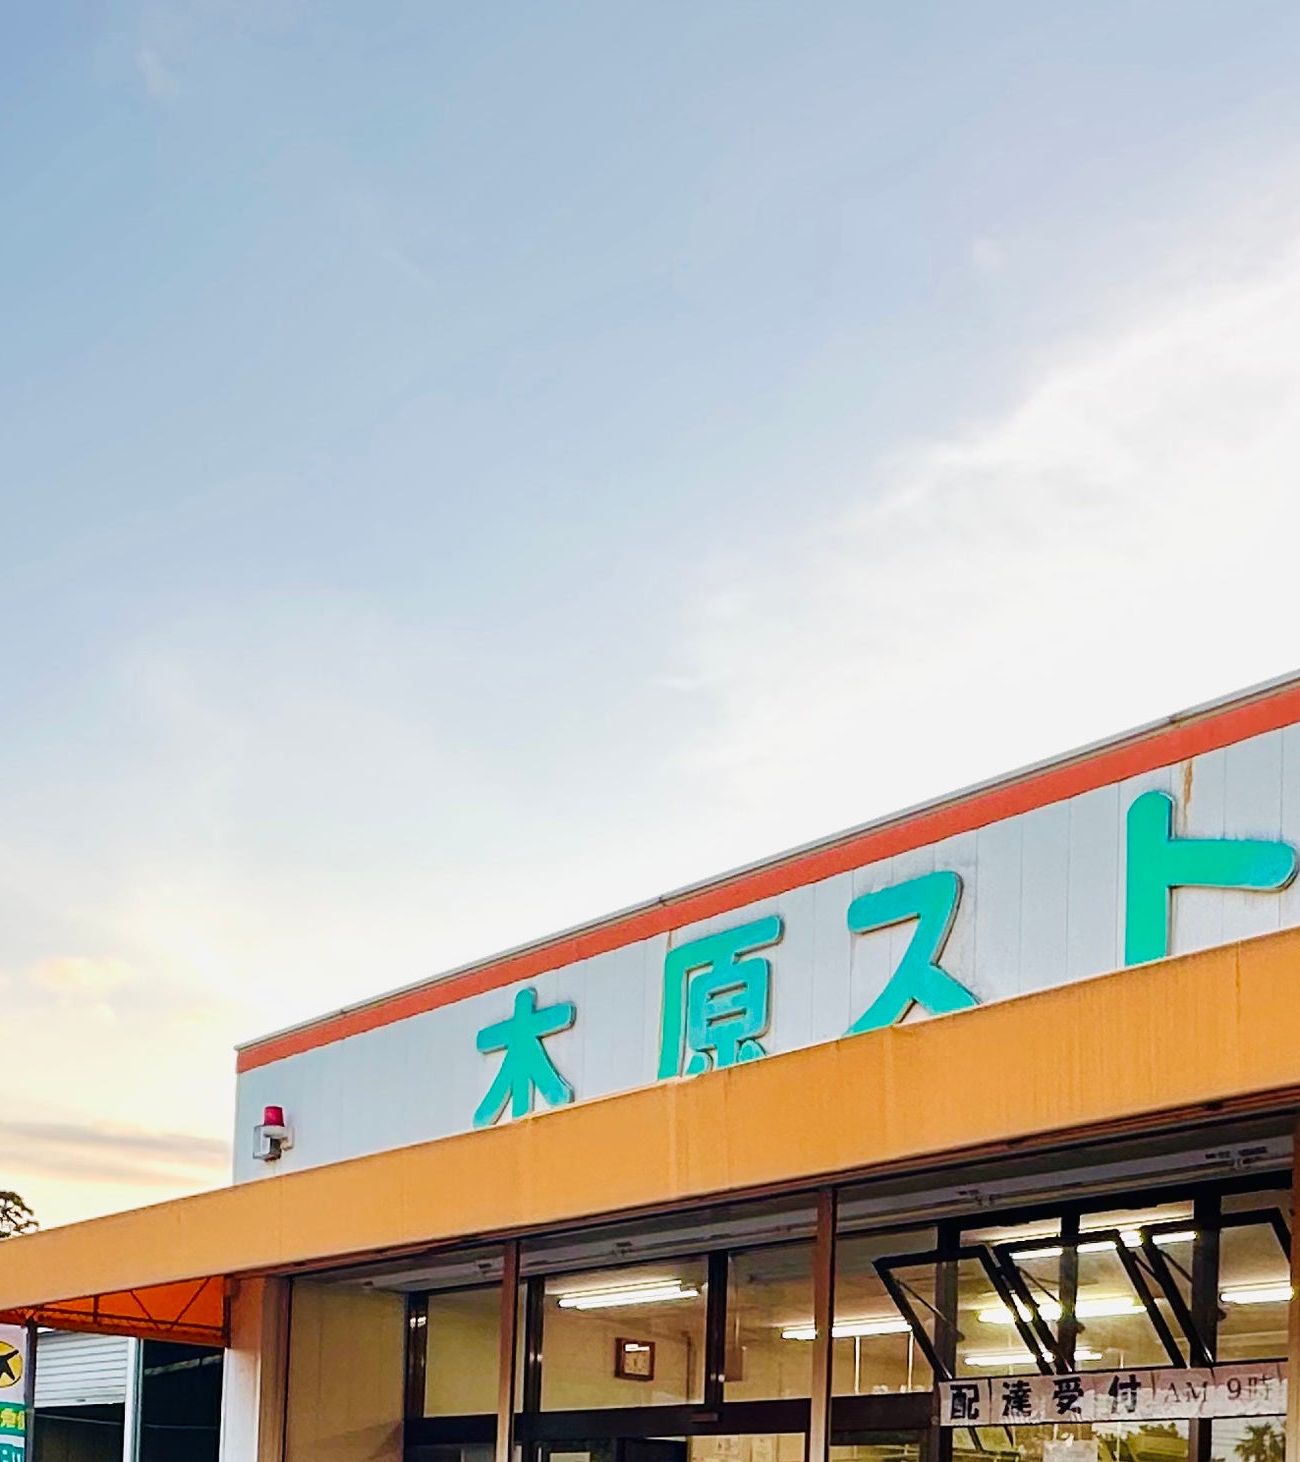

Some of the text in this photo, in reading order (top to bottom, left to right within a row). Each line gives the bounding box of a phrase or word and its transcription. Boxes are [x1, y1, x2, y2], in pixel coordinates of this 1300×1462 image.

[949, 1373, 1142, 1420] 配達受付
[1164, 1380, 1210, 1404] AM
[1226, 1373, 1274, 1401] 9時
